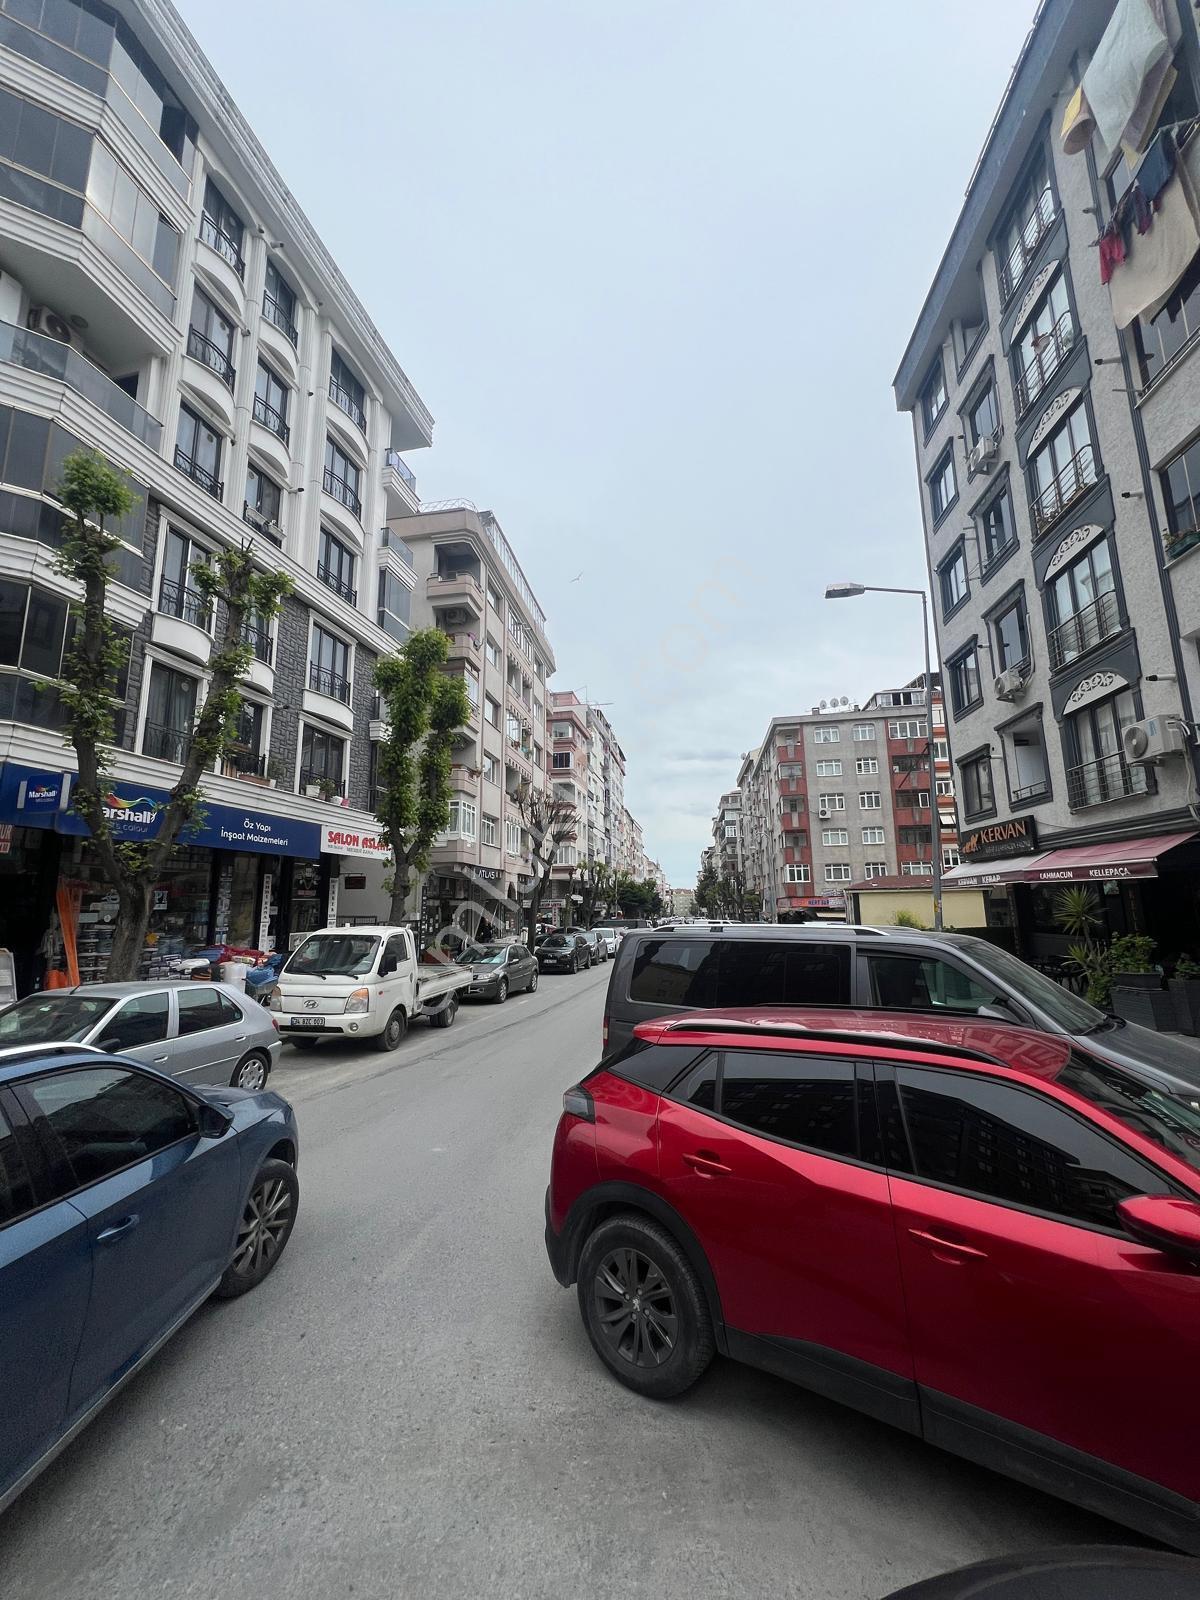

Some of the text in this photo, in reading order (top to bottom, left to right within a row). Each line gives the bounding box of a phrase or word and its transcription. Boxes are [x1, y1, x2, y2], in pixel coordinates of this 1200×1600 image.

[28, 790, 56, 799] Marshall
[102, 807, 151, 824] arshall
[243, 818, 271, 832] Öz Yapı
[980, 821, 1026, 844] KERVAN
[221, 826, 289, 846] İnşaat Malzemeleri
[327, 830, 359, 847] SALON
[478, 869, 495, 879] ATLAS
[1039, 867, 1131, 879] LAHMACUN KELLEPAÇA
